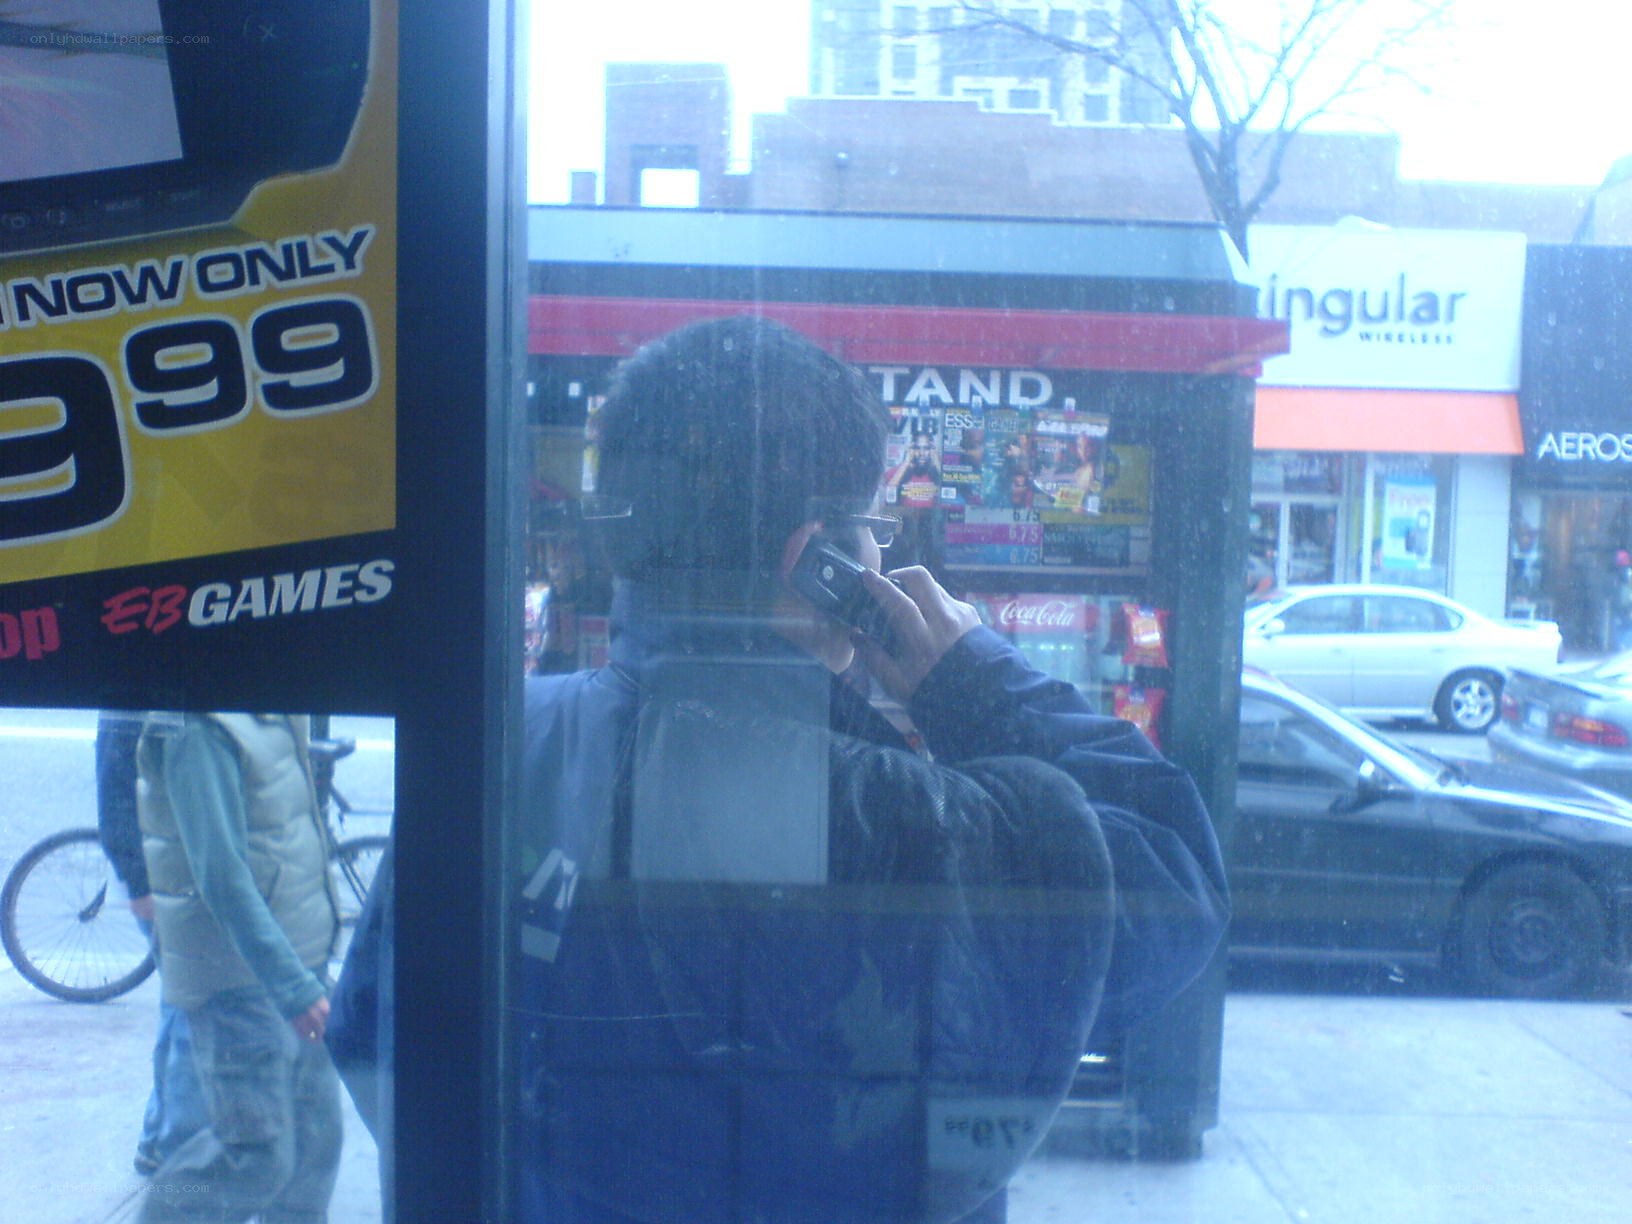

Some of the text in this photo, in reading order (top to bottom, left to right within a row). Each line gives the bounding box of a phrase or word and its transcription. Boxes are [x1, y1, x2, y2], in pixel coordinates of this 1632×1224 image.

[11, 258, 183, 323] NOW
[196, 225, 375, 295] ONLY
[102, 560, 394, 634] EB GAMES
